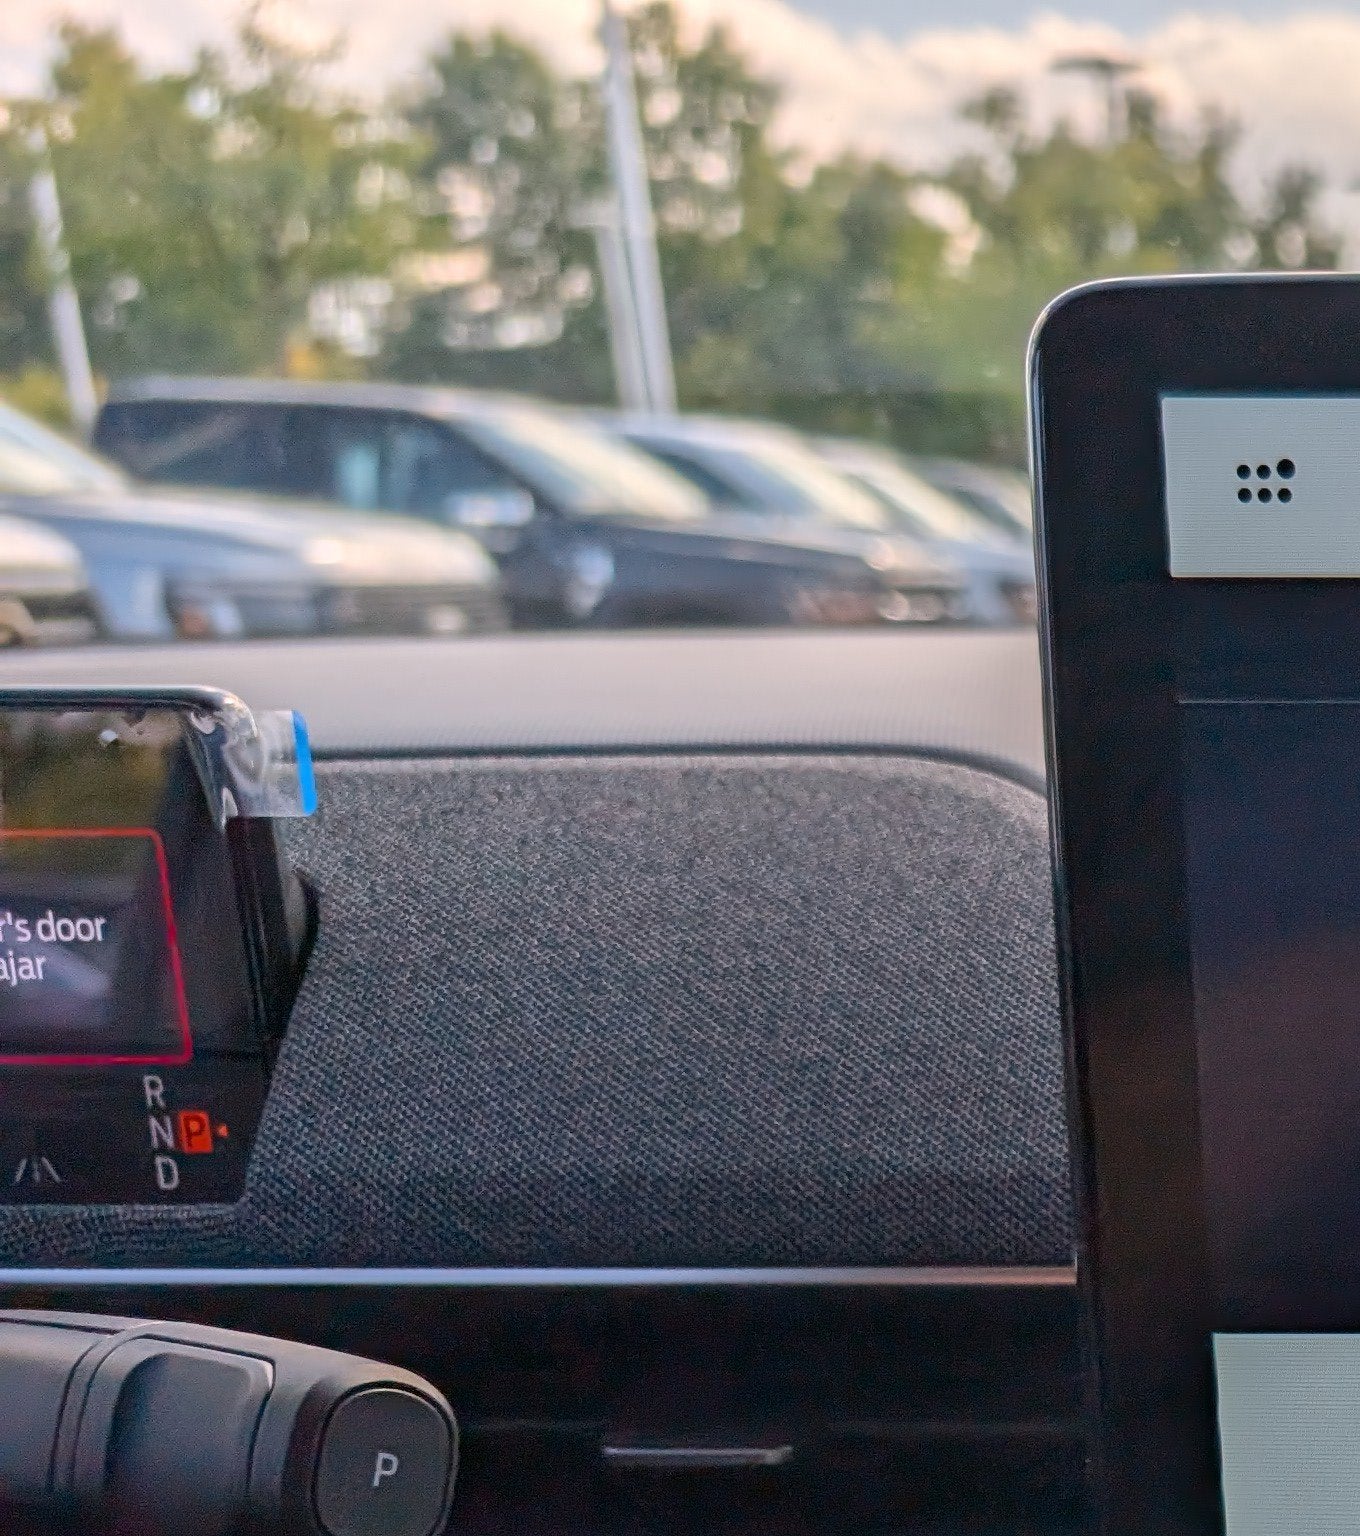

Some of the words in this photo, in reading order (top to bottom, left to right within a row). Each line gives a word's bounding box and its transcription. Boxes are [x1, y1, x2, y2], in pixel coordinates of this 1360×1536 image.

[37, 909, 107, 942] door
[144, 1075, 165, 1108] R
[148, 1115, 176, 1149] N
[183, 1115, 206, 1147] P
[155, 1155, 179, 1190] D
[373, 1452, 399, 1487] P
